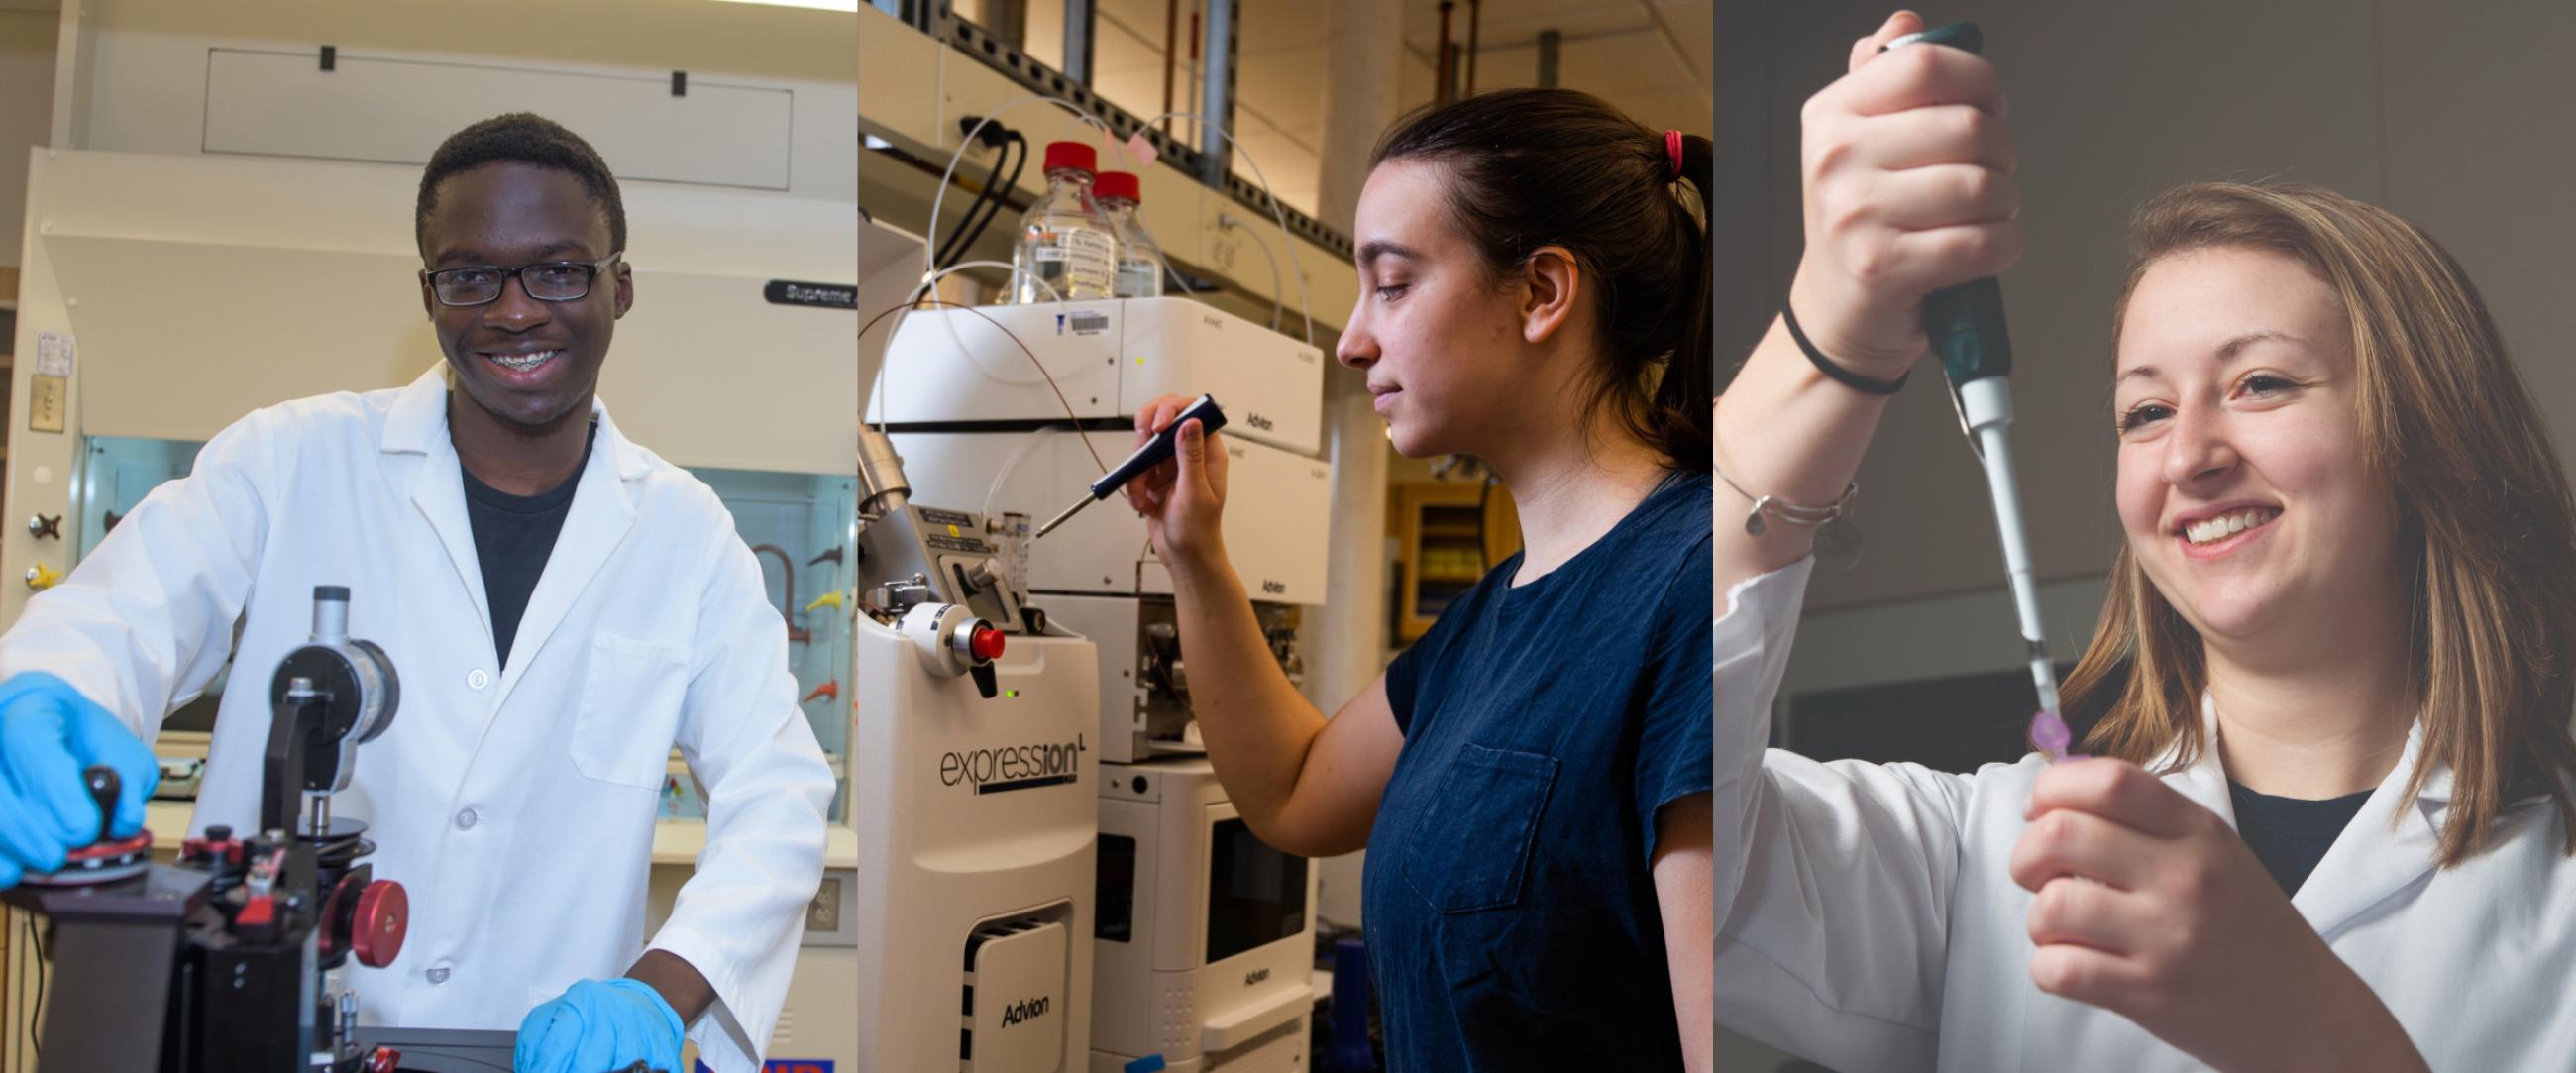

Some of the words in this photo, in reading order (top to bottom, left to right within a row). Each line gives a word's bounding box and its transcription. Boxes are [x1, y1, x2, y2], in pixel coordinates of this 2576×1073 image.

[787, 284, 851, 302] Supreme
[940, 743, 1078, 796] expression
[1002, 996, 1049, 1028] Advion
